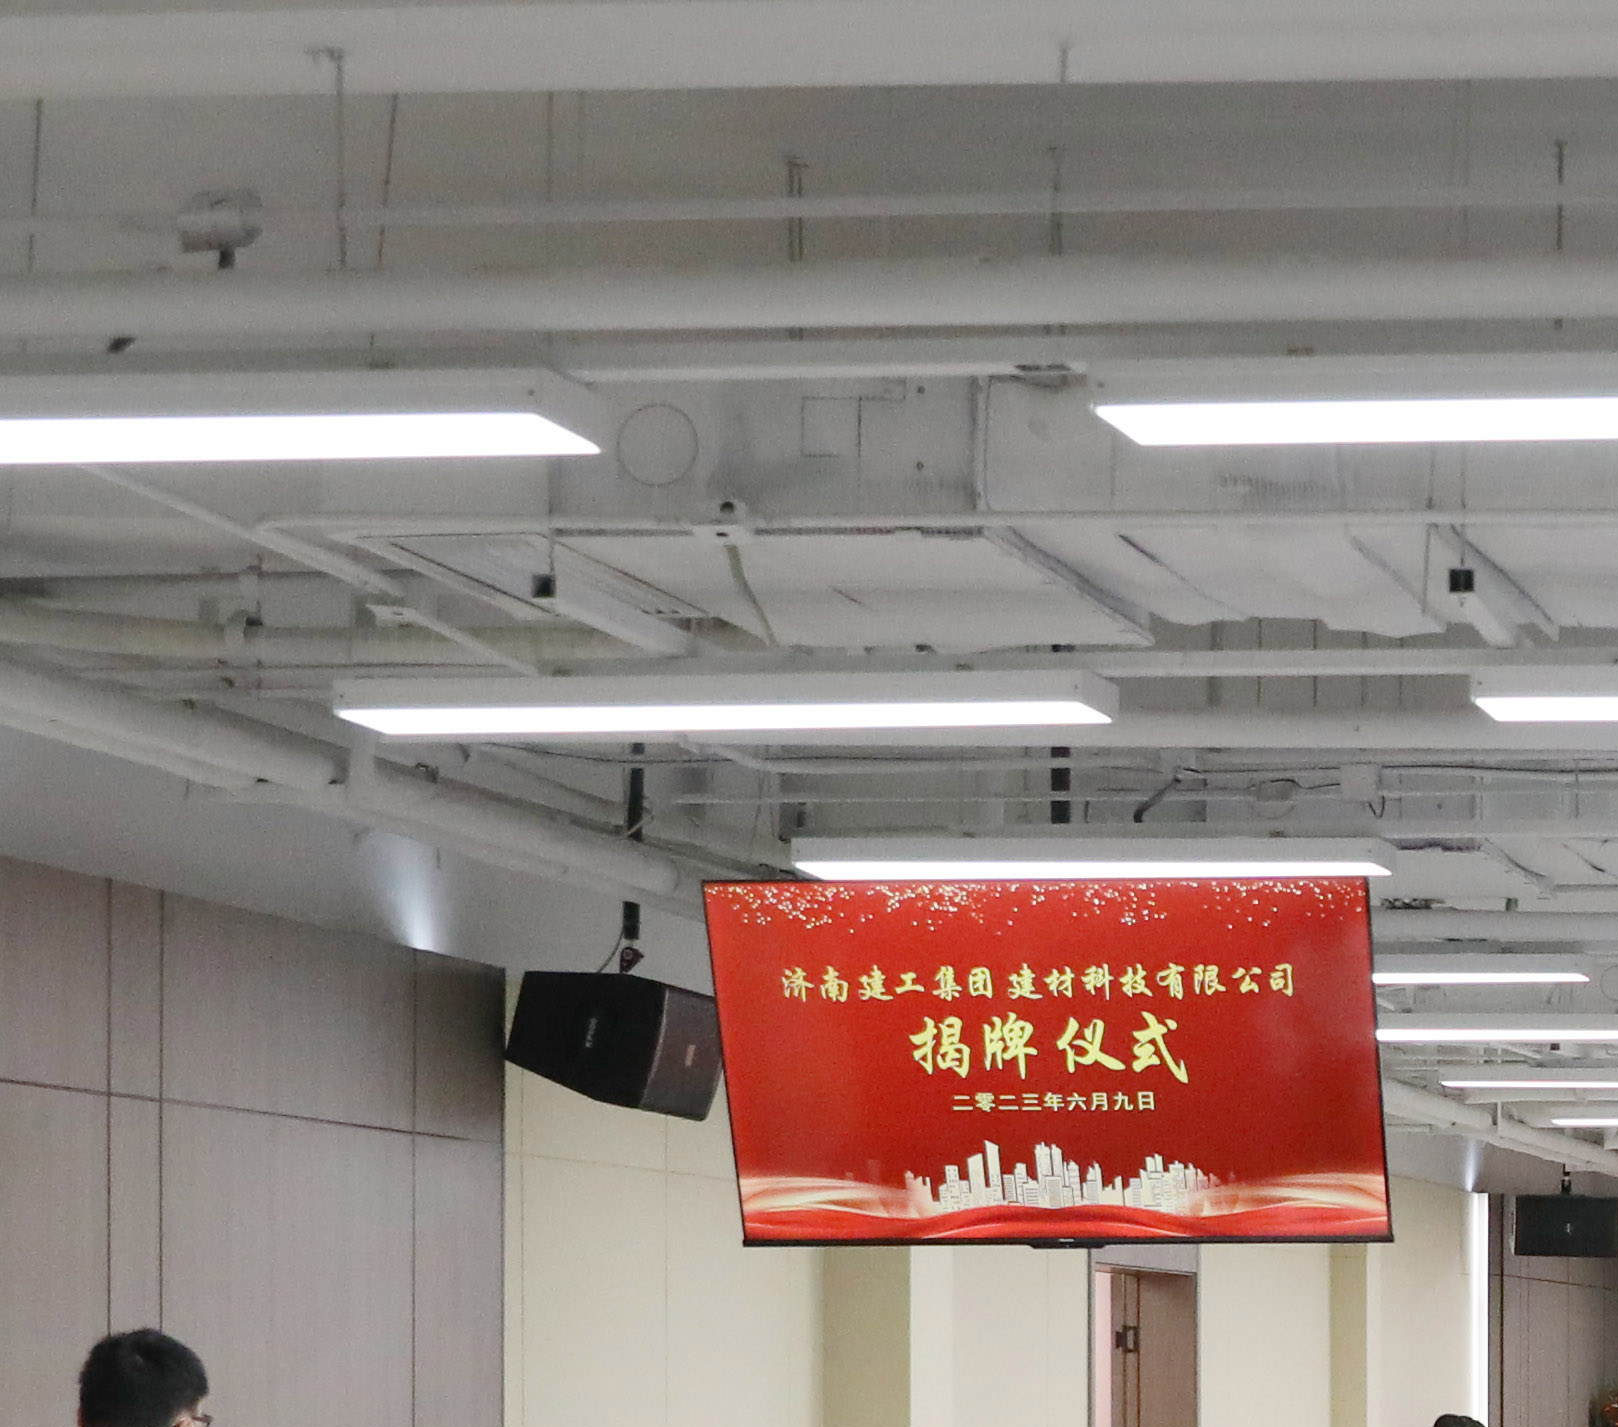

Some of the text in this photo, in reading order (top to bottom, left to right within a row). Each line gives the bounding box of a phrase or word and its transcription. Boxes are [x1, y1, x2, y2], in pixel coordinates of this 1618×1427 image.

[908, 1011, 1190, 1084] 揭牌仪式
[952, 1091, 1156, 1113] 二零二三年六月九日
